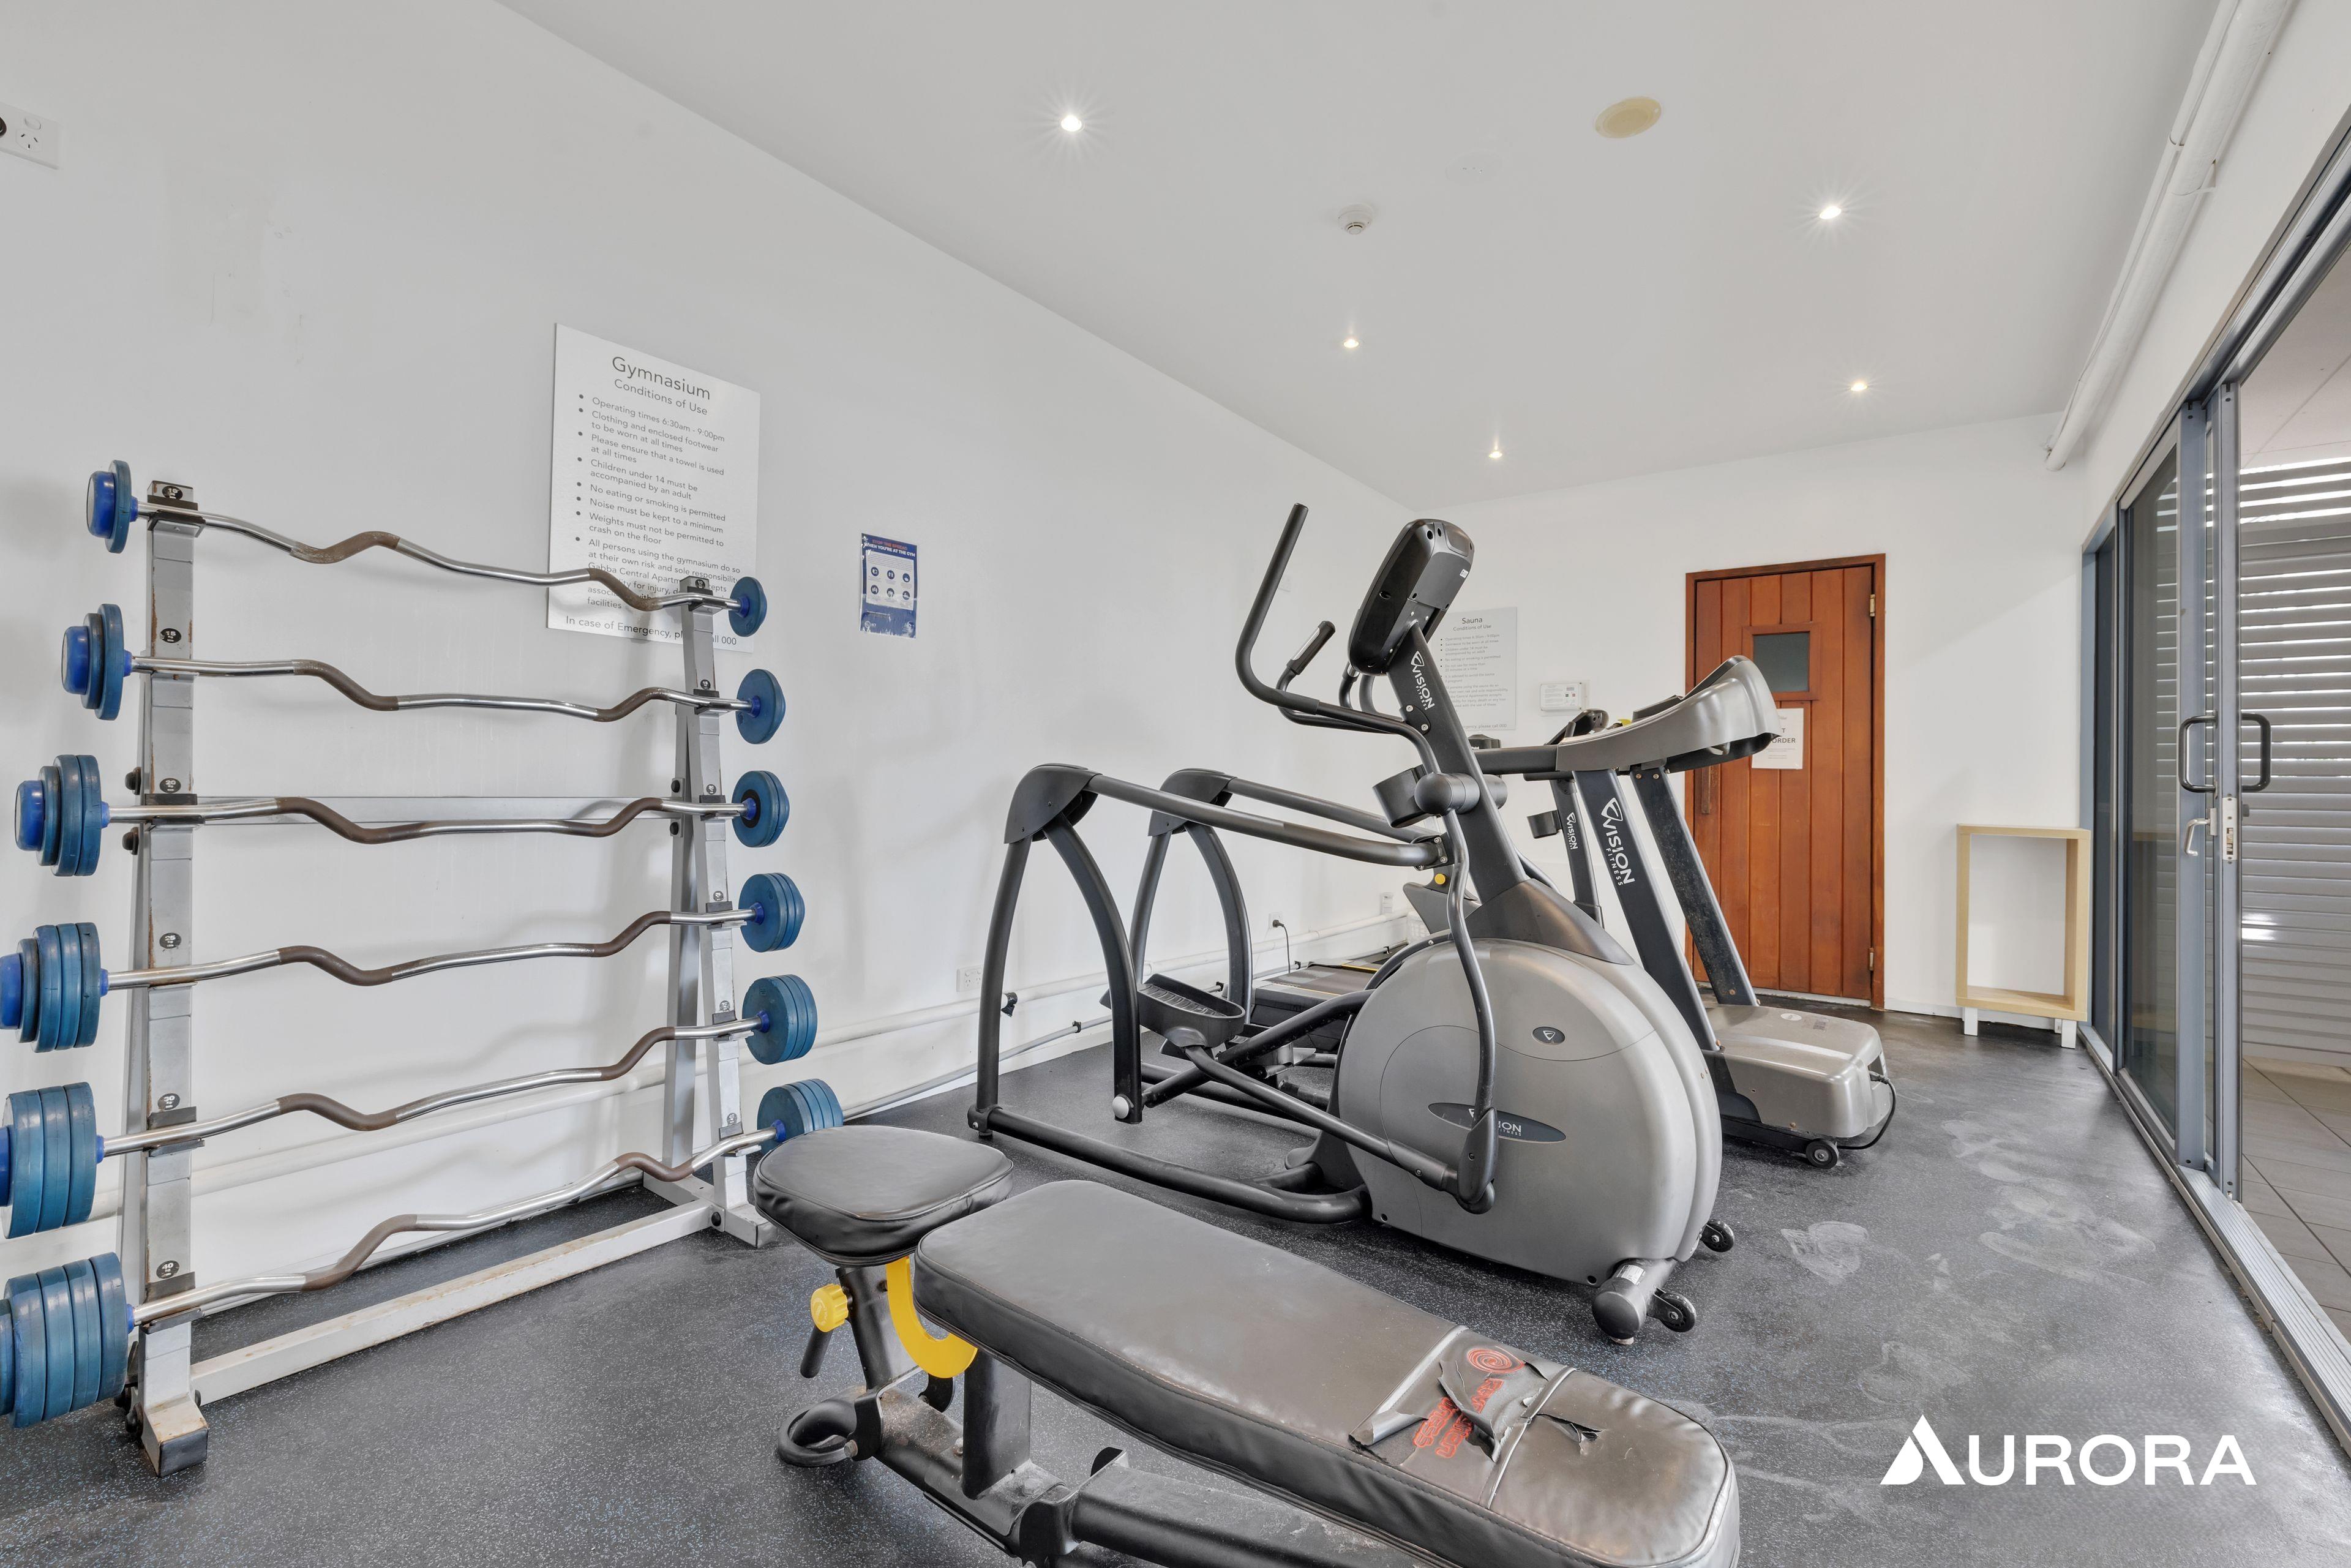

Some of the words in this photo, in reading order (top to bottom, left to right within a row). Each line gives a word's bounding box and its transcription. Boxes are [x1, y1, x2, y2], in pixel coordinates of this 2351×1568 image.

[612, 356, 710, 400] Gymnasium
[614, 378, 672, 405] Conditions
[675, 399, 686, 408] of
[689, 402, 708, 415] Use
[591, 410, 628, 429] Clothing
[631, 423, 646, 432] and
[648, 428, 683, 443] enclosed
[684, 437, 719, 452] footwear
[592, 397, 636, 418] Operating
[638, 411, 660, 424] times
[662, 418, 691, 432] 6:30am
[697, 427, 725, 442] 9:00pm
[591, 421, 601, 430] to
[603, 423, 615, 433] be
[617, 429, 638, 440] worn
[650, 438, 659, 446] all
[661, 441, 683, 452] times
[591, 433, 619, 448] Please
[621, 443, 649, 456] ensure
[650, 450, 667, 461] that
[675, 457, 697, 468] towel
[699, 462, 705, 471] is
[707, 467, 724, 476] used
[614, 451, 637, 463] times
[590, 459, 627, 475] Children
[629, 470, 653, 481] under
[656, 475, 665, 484] 14
[667, 479, 686, 489] must
[688, 482, 698, 492] be
[590, 471, 647, 489] accompanied
[648, 482, 659, 493] by
[672, 490, 692, 500] adult
[590, 484, 604, 493] No
[606, 489, 632, 502] eating
[646, 498, 679, 513] smoking
[681, 505, 687, 513] is
[689, 509, 726, 522] permitted
[590, 497, 615, 510] Noise
[617, 506, 637, 515] must
[640, 508, 651, 518] be
[653, 511, 671, 523] kept
[689, 521, 724, 534] minimum
[589, 512, 624, 527] Weights
[626, 522, 647, 531] must
[664, 527, 675, 537] be
[677, 532, 714, 545] permitted
[589, 525, 612, 535] crash
[627, 531, 641, 541] the
[642, 534, 662, 544] floor
[588, 538, 600, 547] All
[602, 542, 637, 554] persons
[637, 549, 660, 561] using
[661, 552, 675, 561] the
[676, 557, 719, 569] gymnasium
[720, 563, 731, 573] do
[599, 552, 620, 562] their
[641, 560, 655, 569] risk
[674, 567, 691, 577] sole
[620, 568, 649, 579] Central
[651, 573, 680, 584] Apartm
[634, 581, 645, 590] for
[648, 583, 670, 595] injury,
[588, 596, 621, 609] facilities
[566, 615, 575, 625] In
[579, 619, 601, 629] case
[604, 620, 614, 629] of
[618, 622, 671, 639] Emergency,
[721, 636, 737, 645] 000
[1412, 666, 1435, 708] VISION
[1567, 820, 1578, 850] VISION
[1602, 819, 1635, 885] VISION
[1606, 848, 1623, 886] FITNESS
[1498, 1121, 1521, 1133] ION
